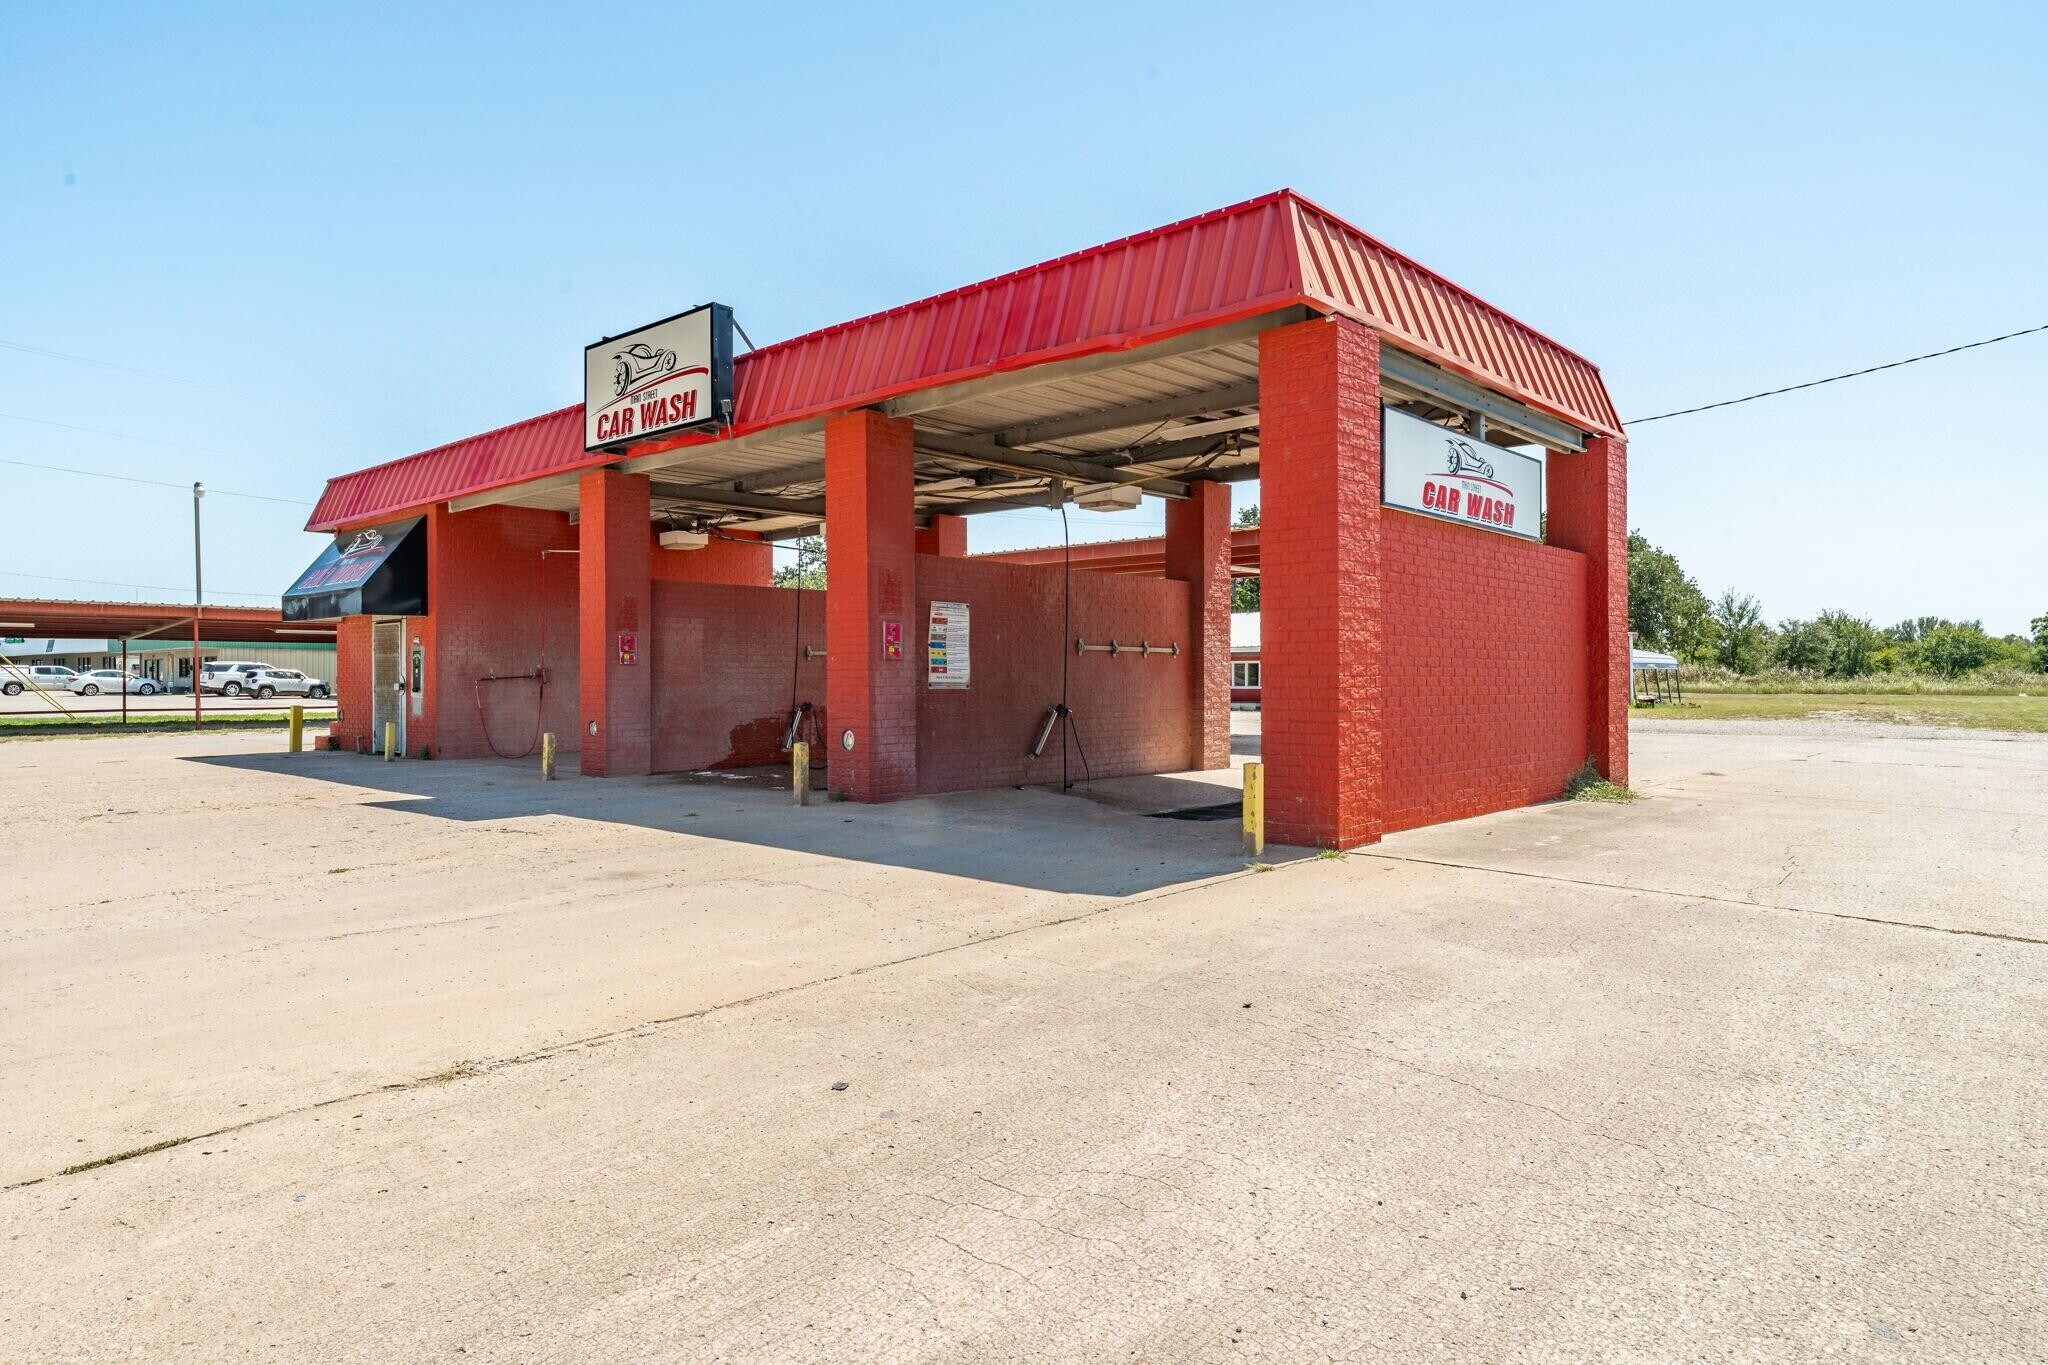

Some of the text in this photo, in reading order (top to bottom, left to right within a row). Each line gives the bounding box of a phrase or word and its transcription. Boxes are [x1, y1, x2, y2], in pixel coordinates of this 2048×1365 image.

[596, 389, 698, 442] CAR WASH
[643, 389, 657, 401] STREET
[1422, 481, 1515, 528] CAR WASH
